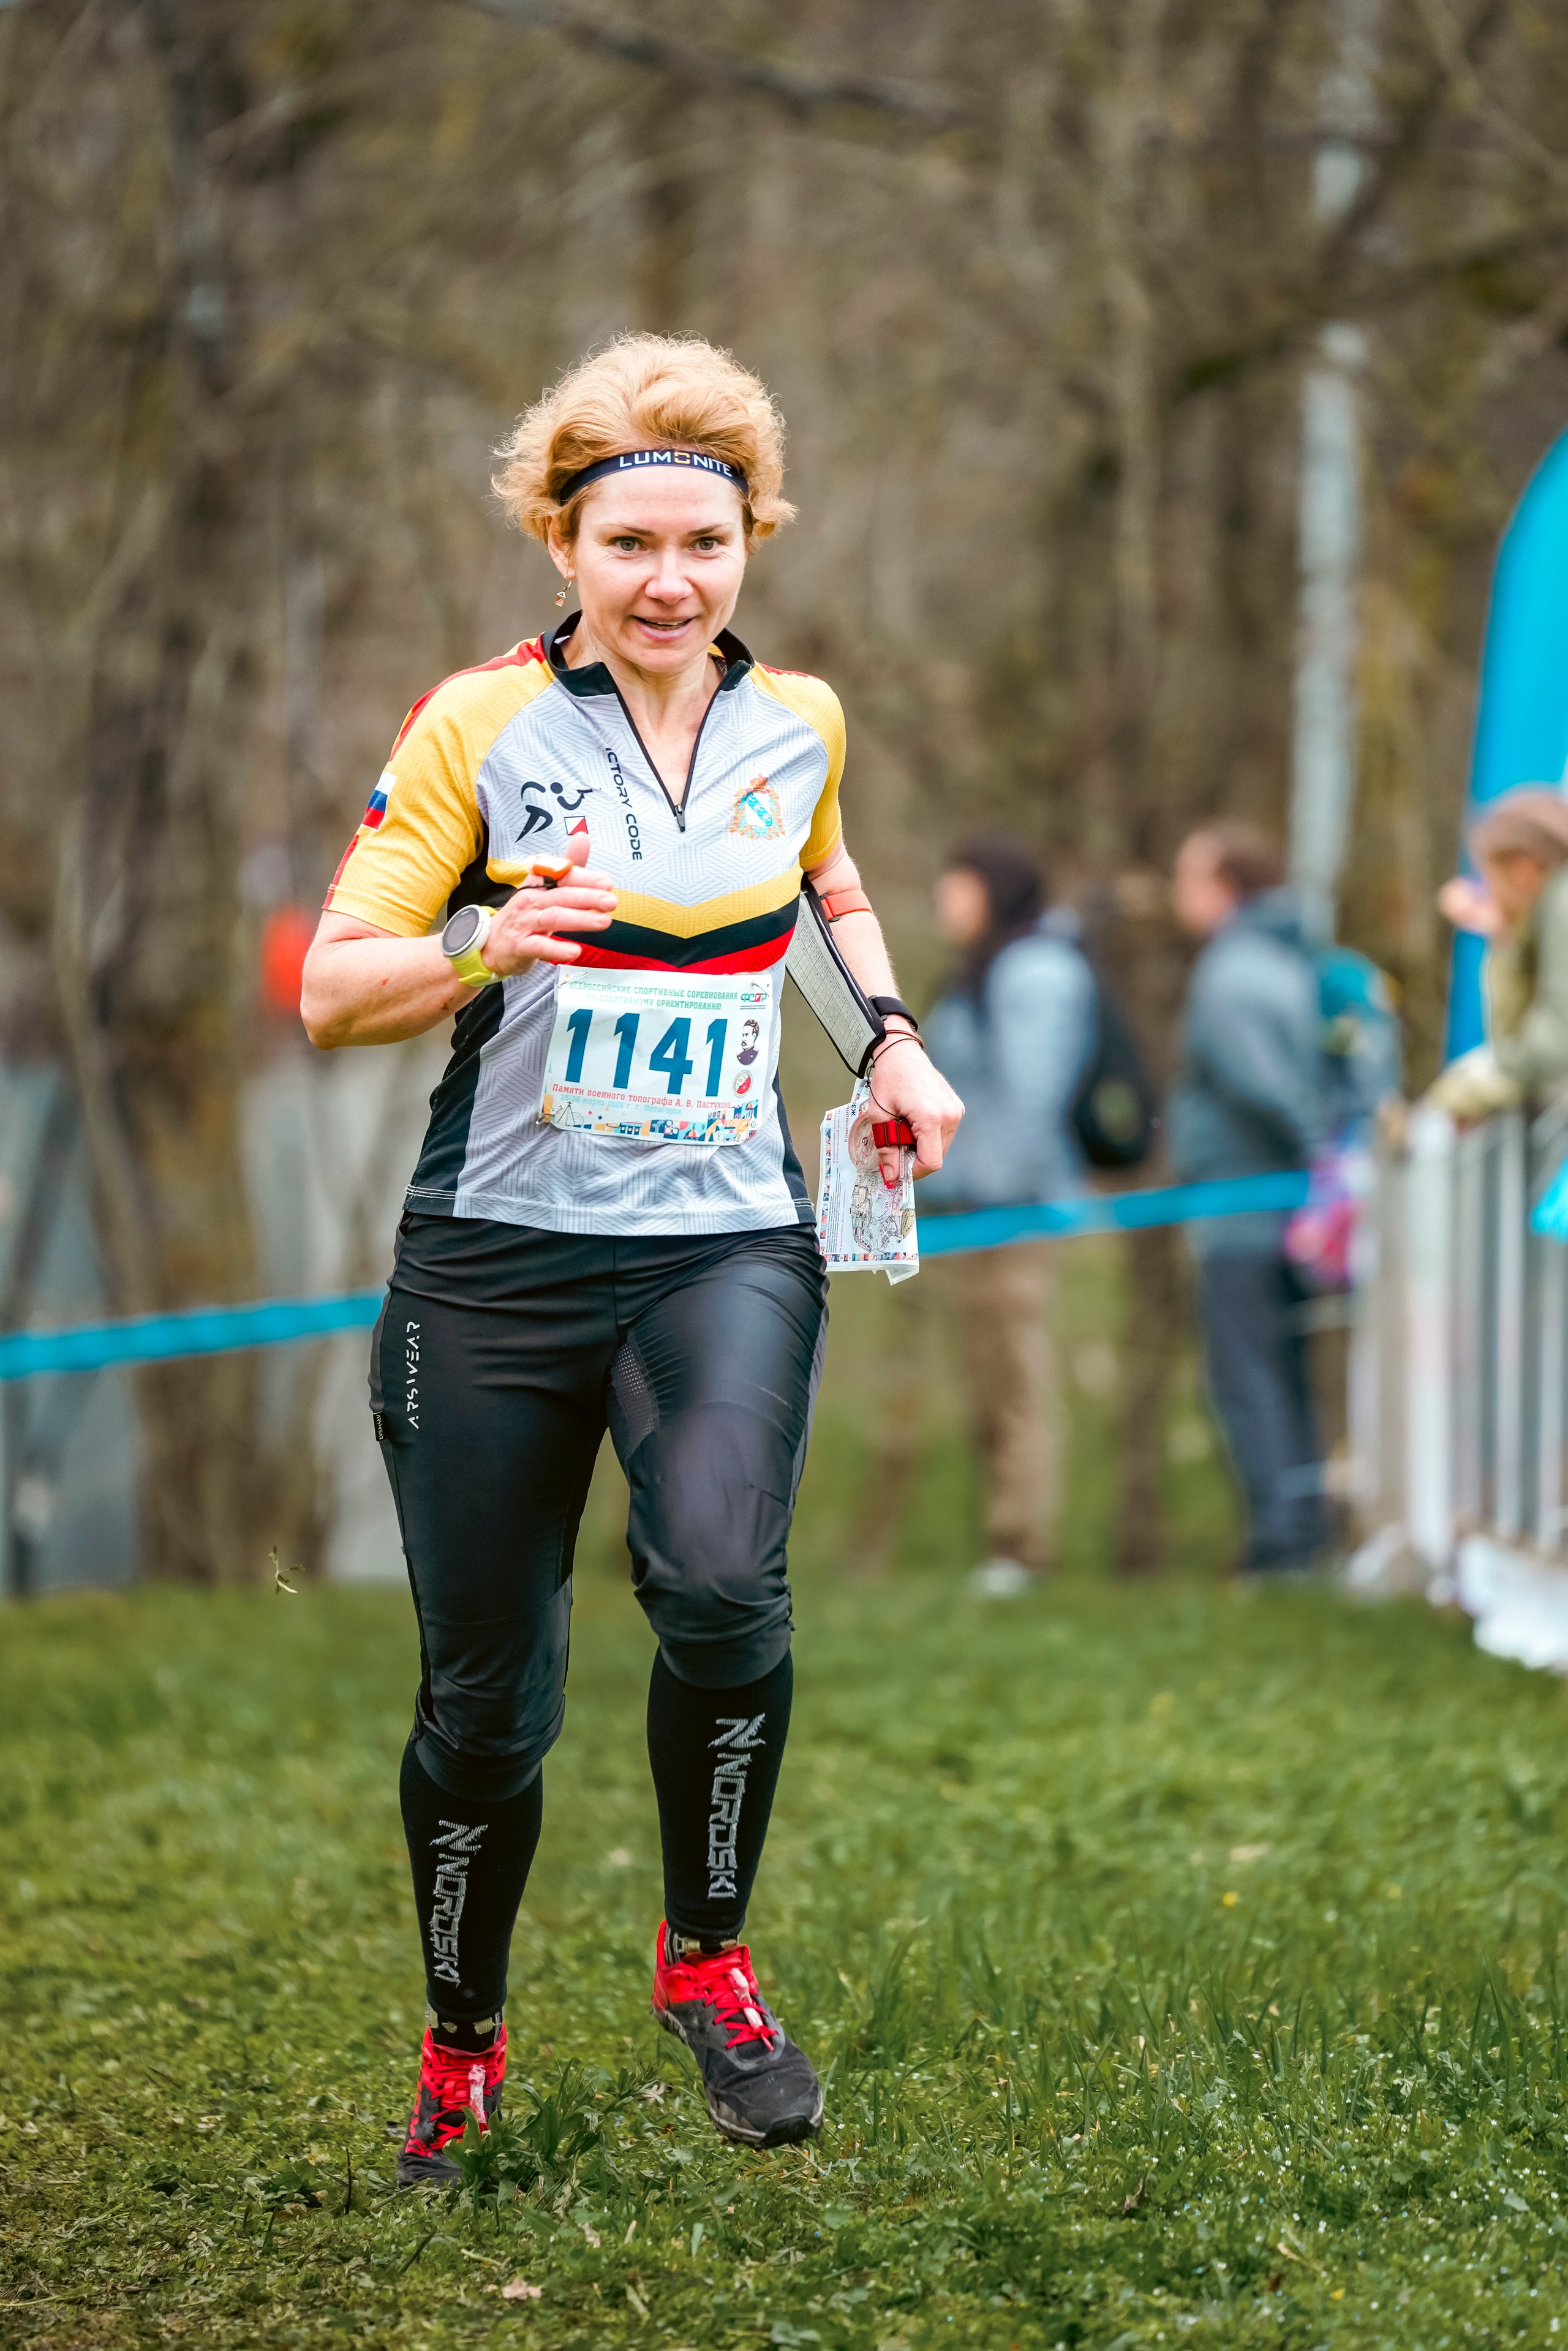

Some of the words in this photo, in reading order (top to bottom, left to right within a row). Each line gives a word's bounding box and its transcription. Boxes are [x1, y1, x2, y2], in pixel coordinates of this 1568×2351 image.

[619, 451, 733, 477] LUMONITE
[626, 813, 643, 861] CODE
[569, 981, 631, 994] ВСЕРОССИЙСКИЕ
[634, 987, 685, 998] СПОРТИВНЫЕ
[687, 991, 737, 1000] СОРЕВНОВАНИЯ
[600, 995, 654, 1006] СПОРТИВНОМУ
[656, 999, 722, 1010] ОРИЕНТИРОВАНИЮ
[565, 1008, 728, 1097] 1141
[552, 1084, 584, 1095] Памяти
[587, 1090, 625, 1100] военного
[628, 1095, 673, 1107] топографа
[696, 1100, 731, 1110] Пастухова
